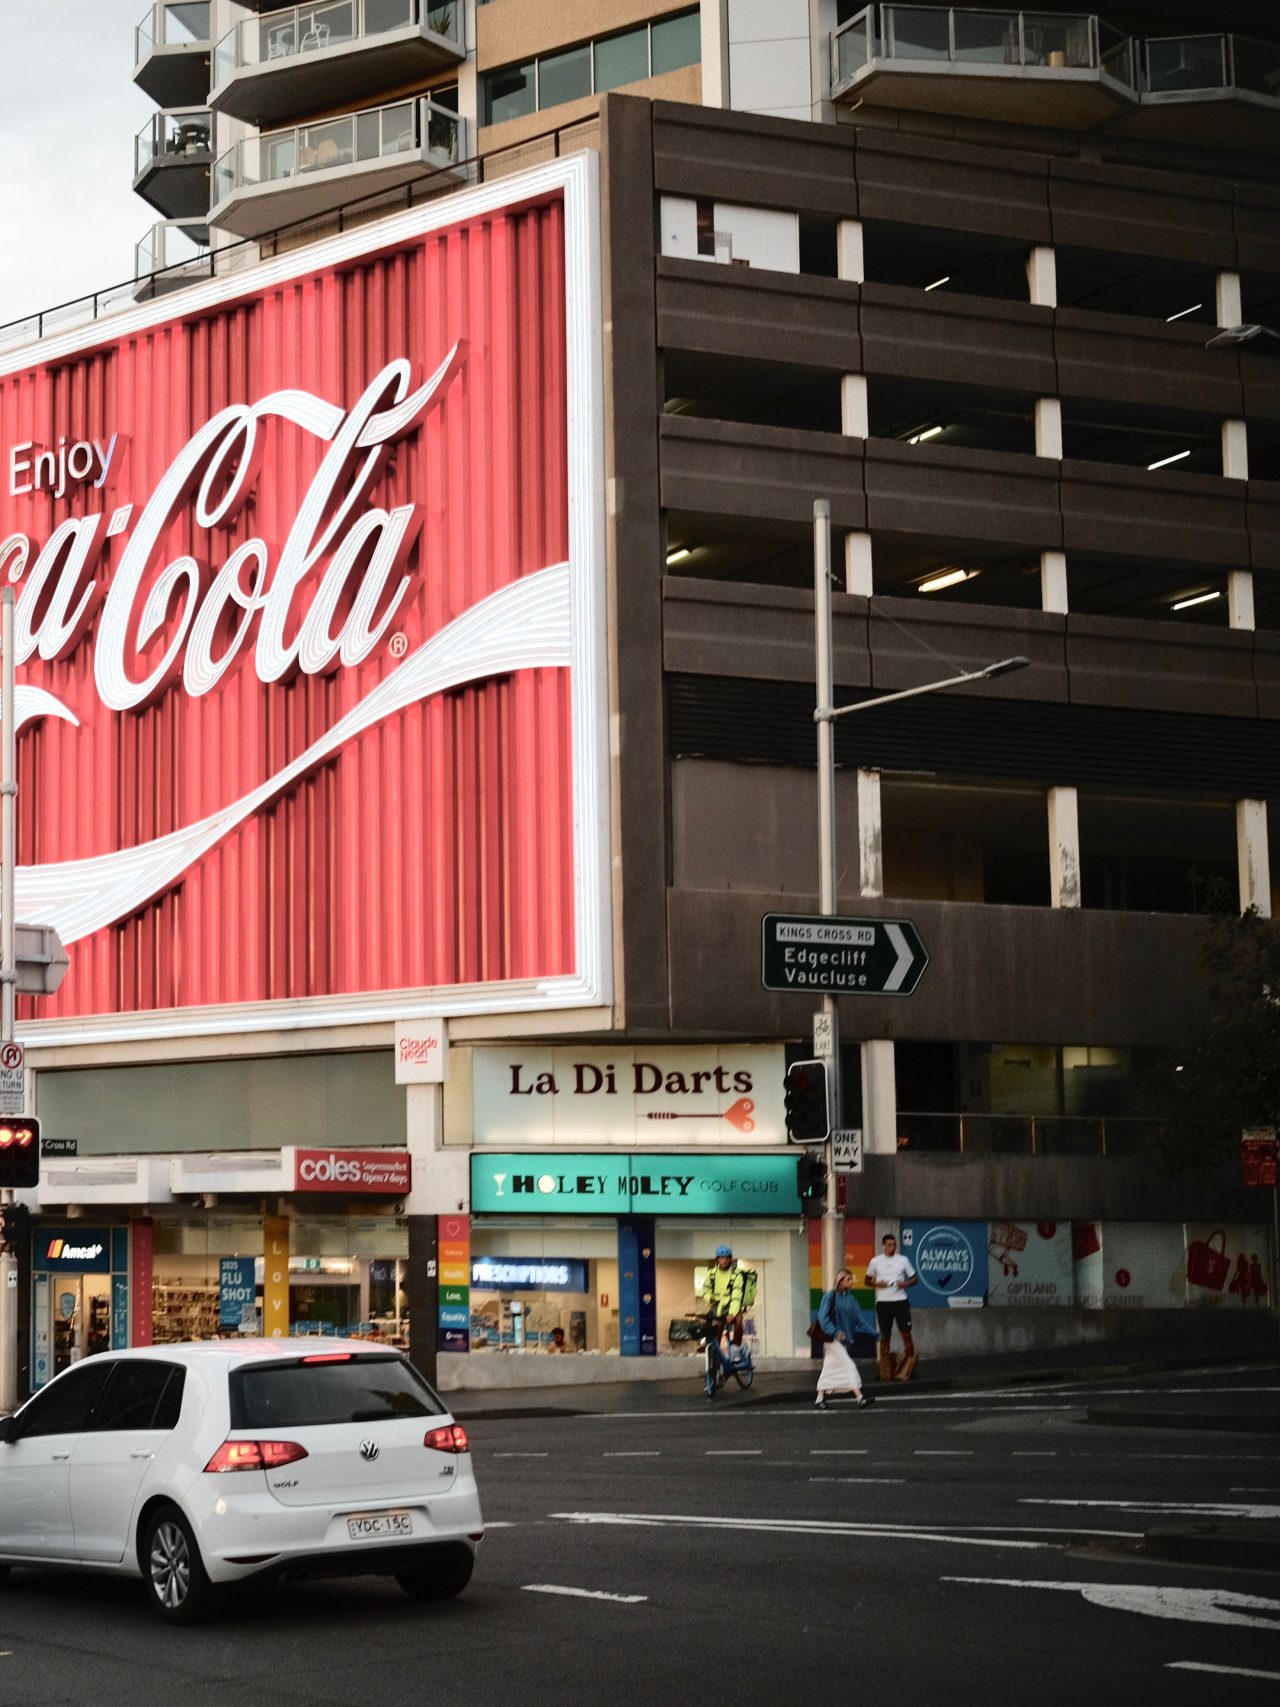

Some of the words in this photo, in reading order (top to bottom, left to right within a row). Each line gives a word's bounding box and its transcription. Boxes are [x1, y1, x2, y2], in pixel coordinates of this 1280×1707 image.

[8, 432, 119, 499] Enjoy
[779, 926, 812, 939] KINGS
[817, 928, 852, 941] CROSS
[858, 930, 872, 942] RD
[784, 947, 867, 968] Edgecliff
[784, 968, 867, 987] Vaucluse
[400, 1036, 437, 1050] Claude
[400, 1049, 428, 1062] Neon
[1, 1070, 13, 1080] NO
[16, 1070, 23, 1080] U
[509, 1064, 560, 1095] La
[573, 1063, 618, 1095] Di
[632, 1063, 754, 1095] Darts
[2, 1081, 22, 1090] TURN
[834, 1132, 858, 1143] ONE
[45, 1140, 65, 1150] Cross
[66, 1141, 76, 1150] Rd
[833, 1146, 858, 1158] WAY
[300, 1154, 361, 1182] coles
[618, 1175, 695, 1196] MOLEY
[700, 1180, 738, 1193] GOLF
[740, 1180, 779, 1194] CLUB
[921, 1249, 969, 1262] ALWAYS
[921, 1261, 969, 1272] AVAILABLE
[222, 1272, 242, 1284] FLU
[222, 1287, 251, 1301] SHOT
